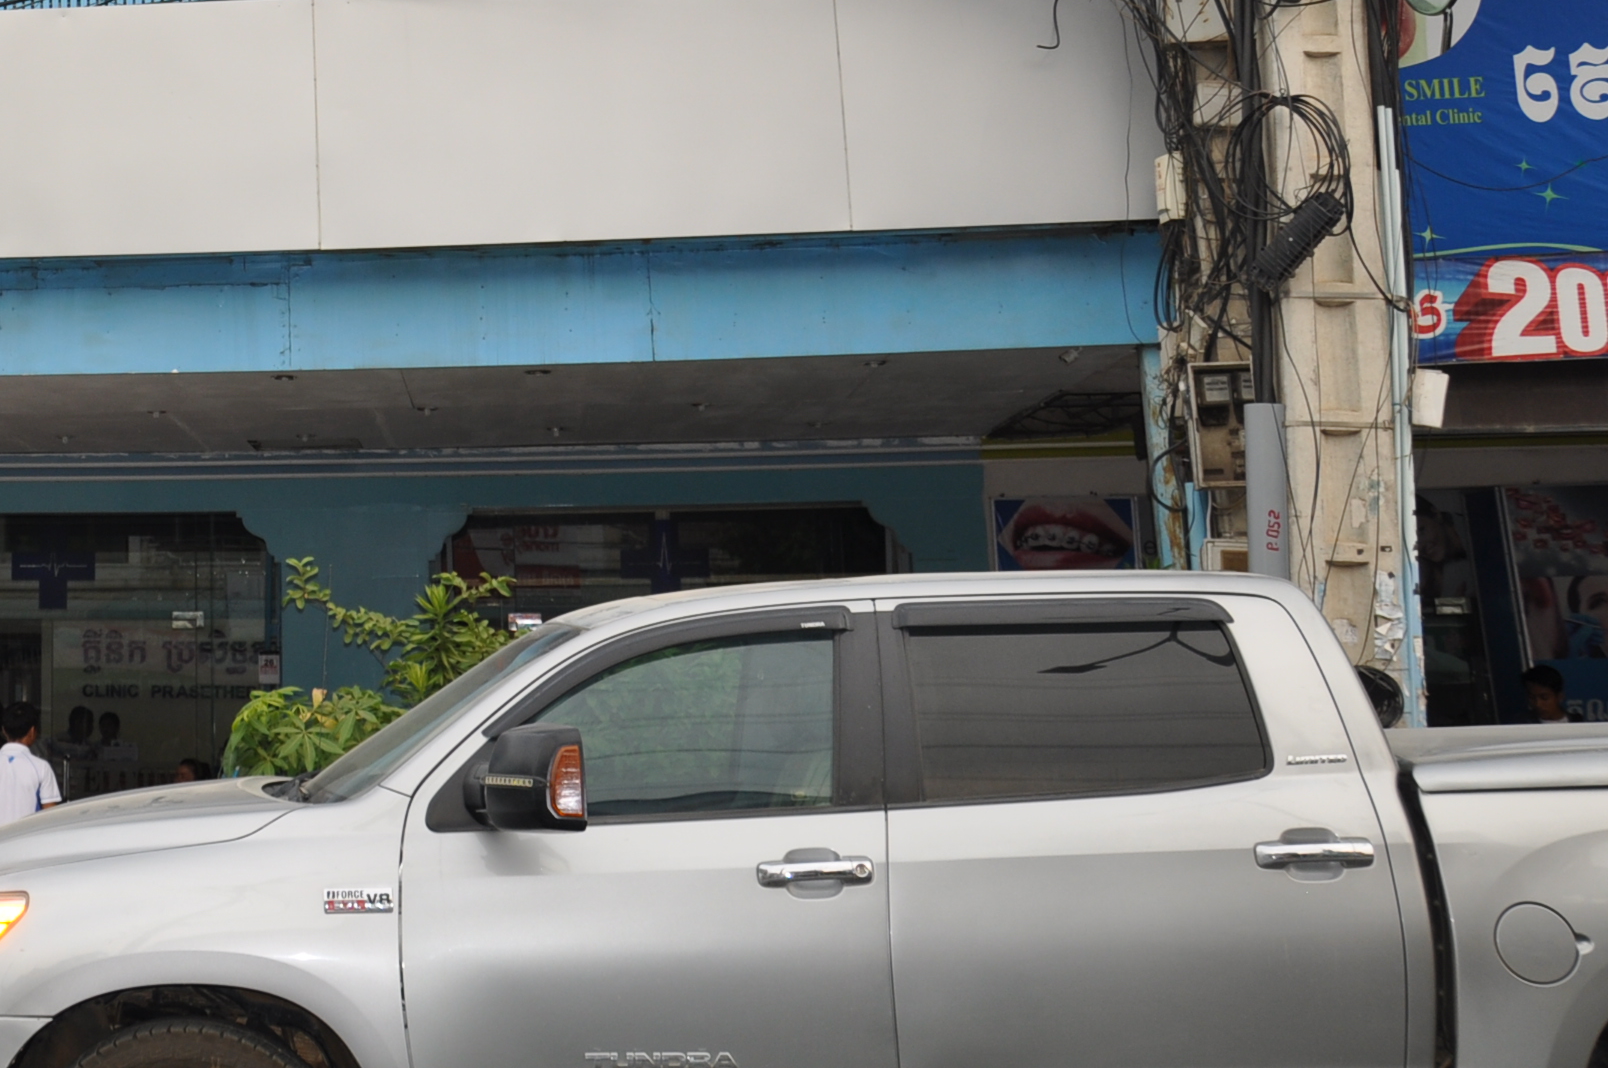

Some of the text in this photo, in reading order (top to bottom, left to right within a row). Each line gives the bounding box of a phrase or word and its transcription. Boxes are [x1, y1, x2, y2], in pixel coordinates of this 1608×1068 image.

[1404, 76, 1486, 101] SMILE
[1436, 108, 1482, 125] Clinic
[82, 684, 139, 699] CLINIC
